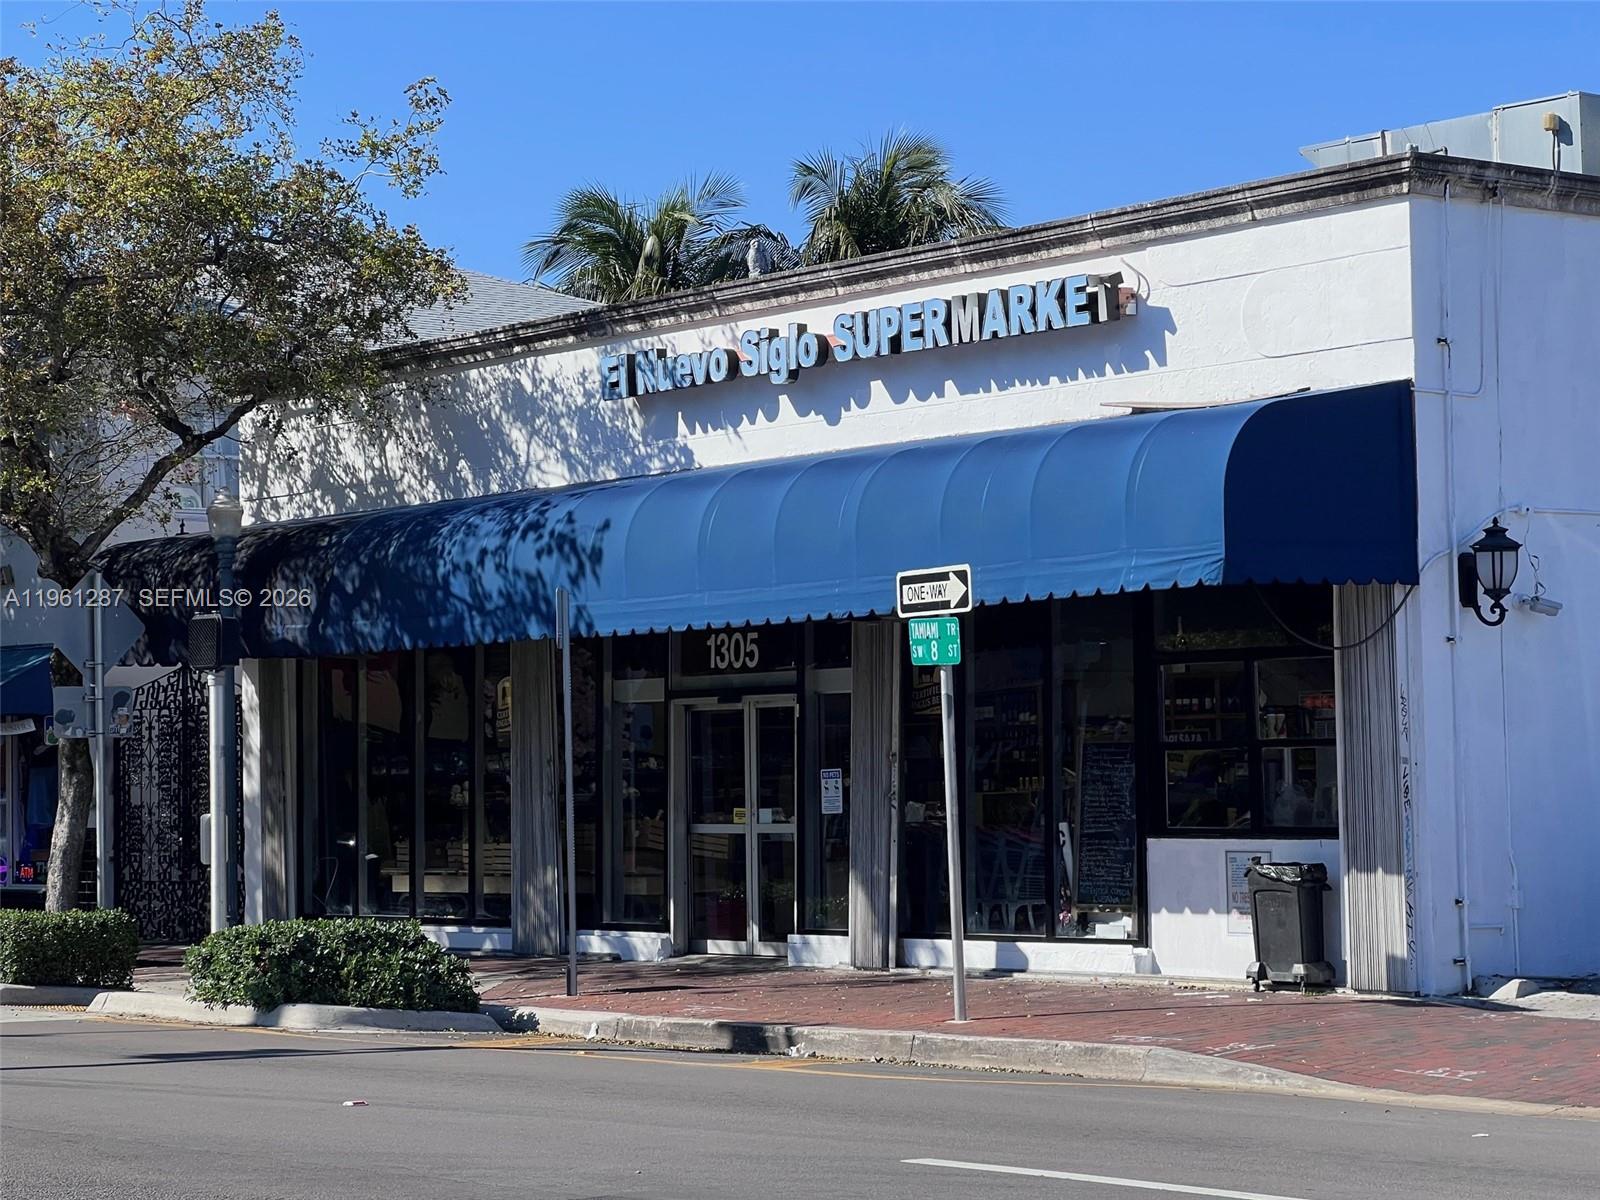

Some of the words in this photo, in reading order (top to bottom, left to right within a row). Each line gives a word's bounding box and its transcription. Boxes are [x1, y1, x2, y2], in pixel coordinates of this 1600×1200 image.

[601, 352, 629, 400] El
[635, 347, 728, 395] Nuevo
[740, 323, 818, 384] Siglo
[833, 272, 1123, 361] SUPERMARKET
[911, 622, 938, 639] TAMIAMI
[946, 623, 956, 635] TR
[706, 632, 759, 669] 1305
[912, 645, 923, 657] SW
[930, 640, 938, 661] 8
[948, 644, 958, 657] ST
[19, 866, 34, 879] ATM
